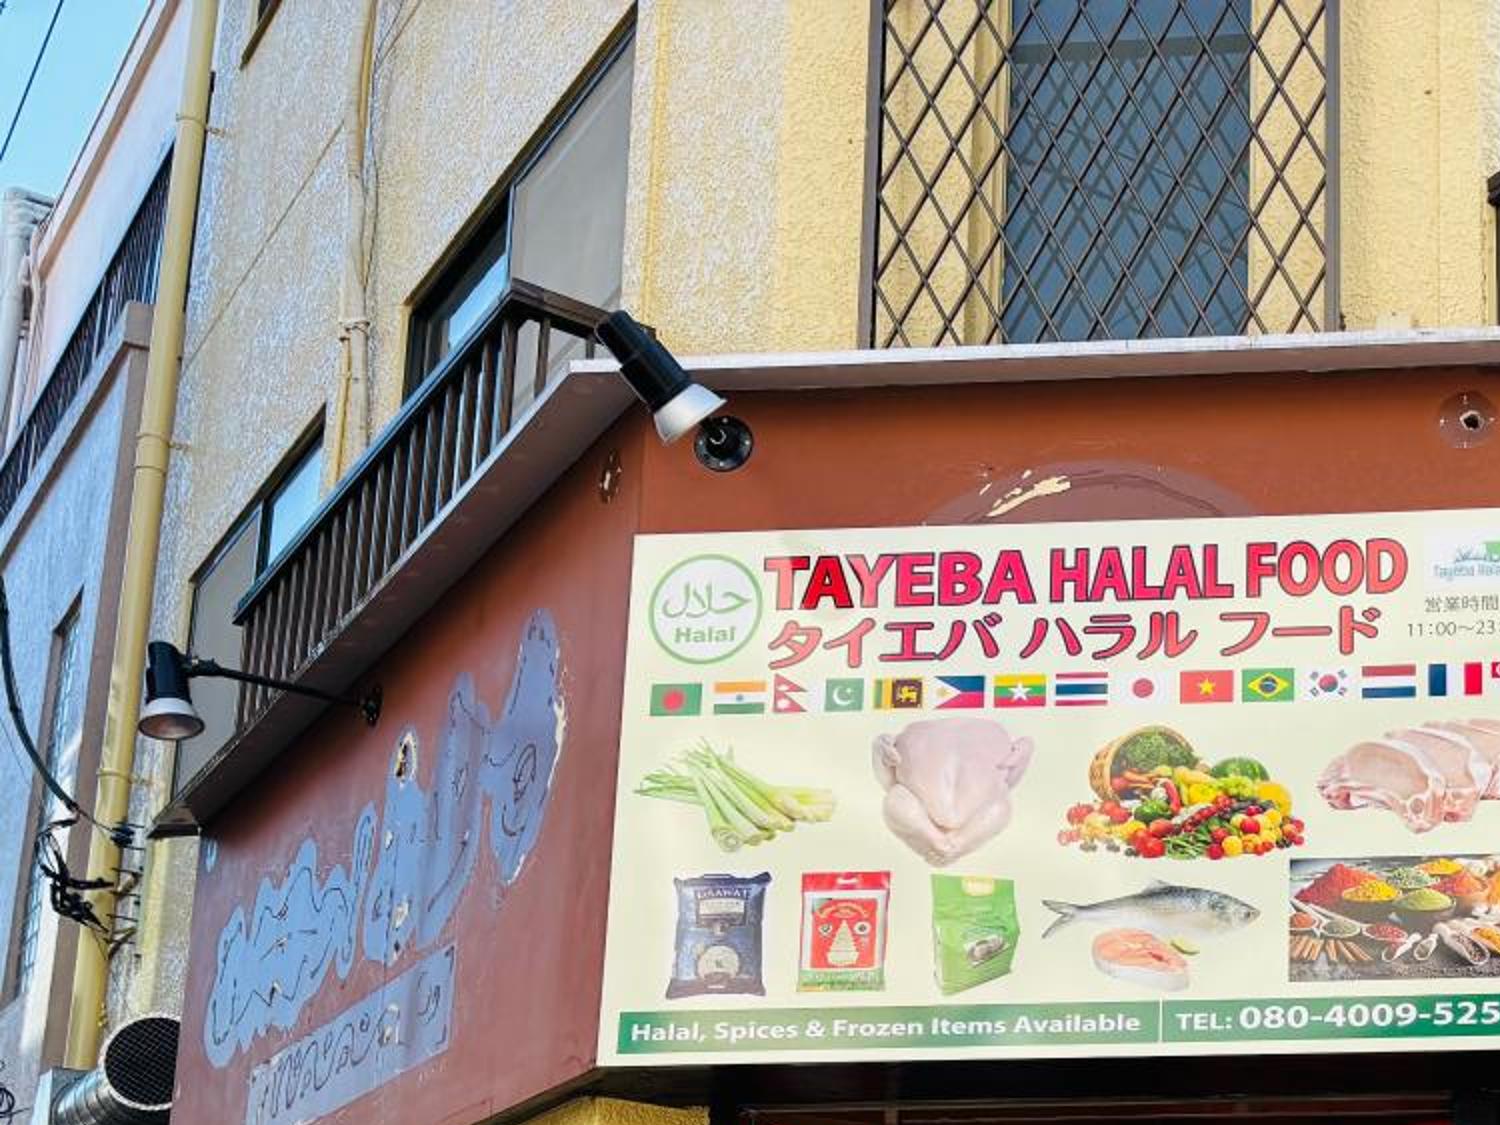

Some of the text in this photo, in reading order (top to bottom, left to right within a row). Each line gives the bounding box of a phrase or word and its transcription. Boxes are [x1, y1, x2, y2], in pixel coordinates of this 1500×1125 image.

[764, 538, 1409, 610] TAYEBA HALAL FOOD
[662, 580, 752, 619] حلال
[673, 625, 737, 645] Halal
[768, 605, 1381, 670] タイエバ ハラル フード
[631, 1014, 1141, 1042] Halal, Spices & Frozen Items Available
[1175, 1012, 1233, 1031] TEL:
